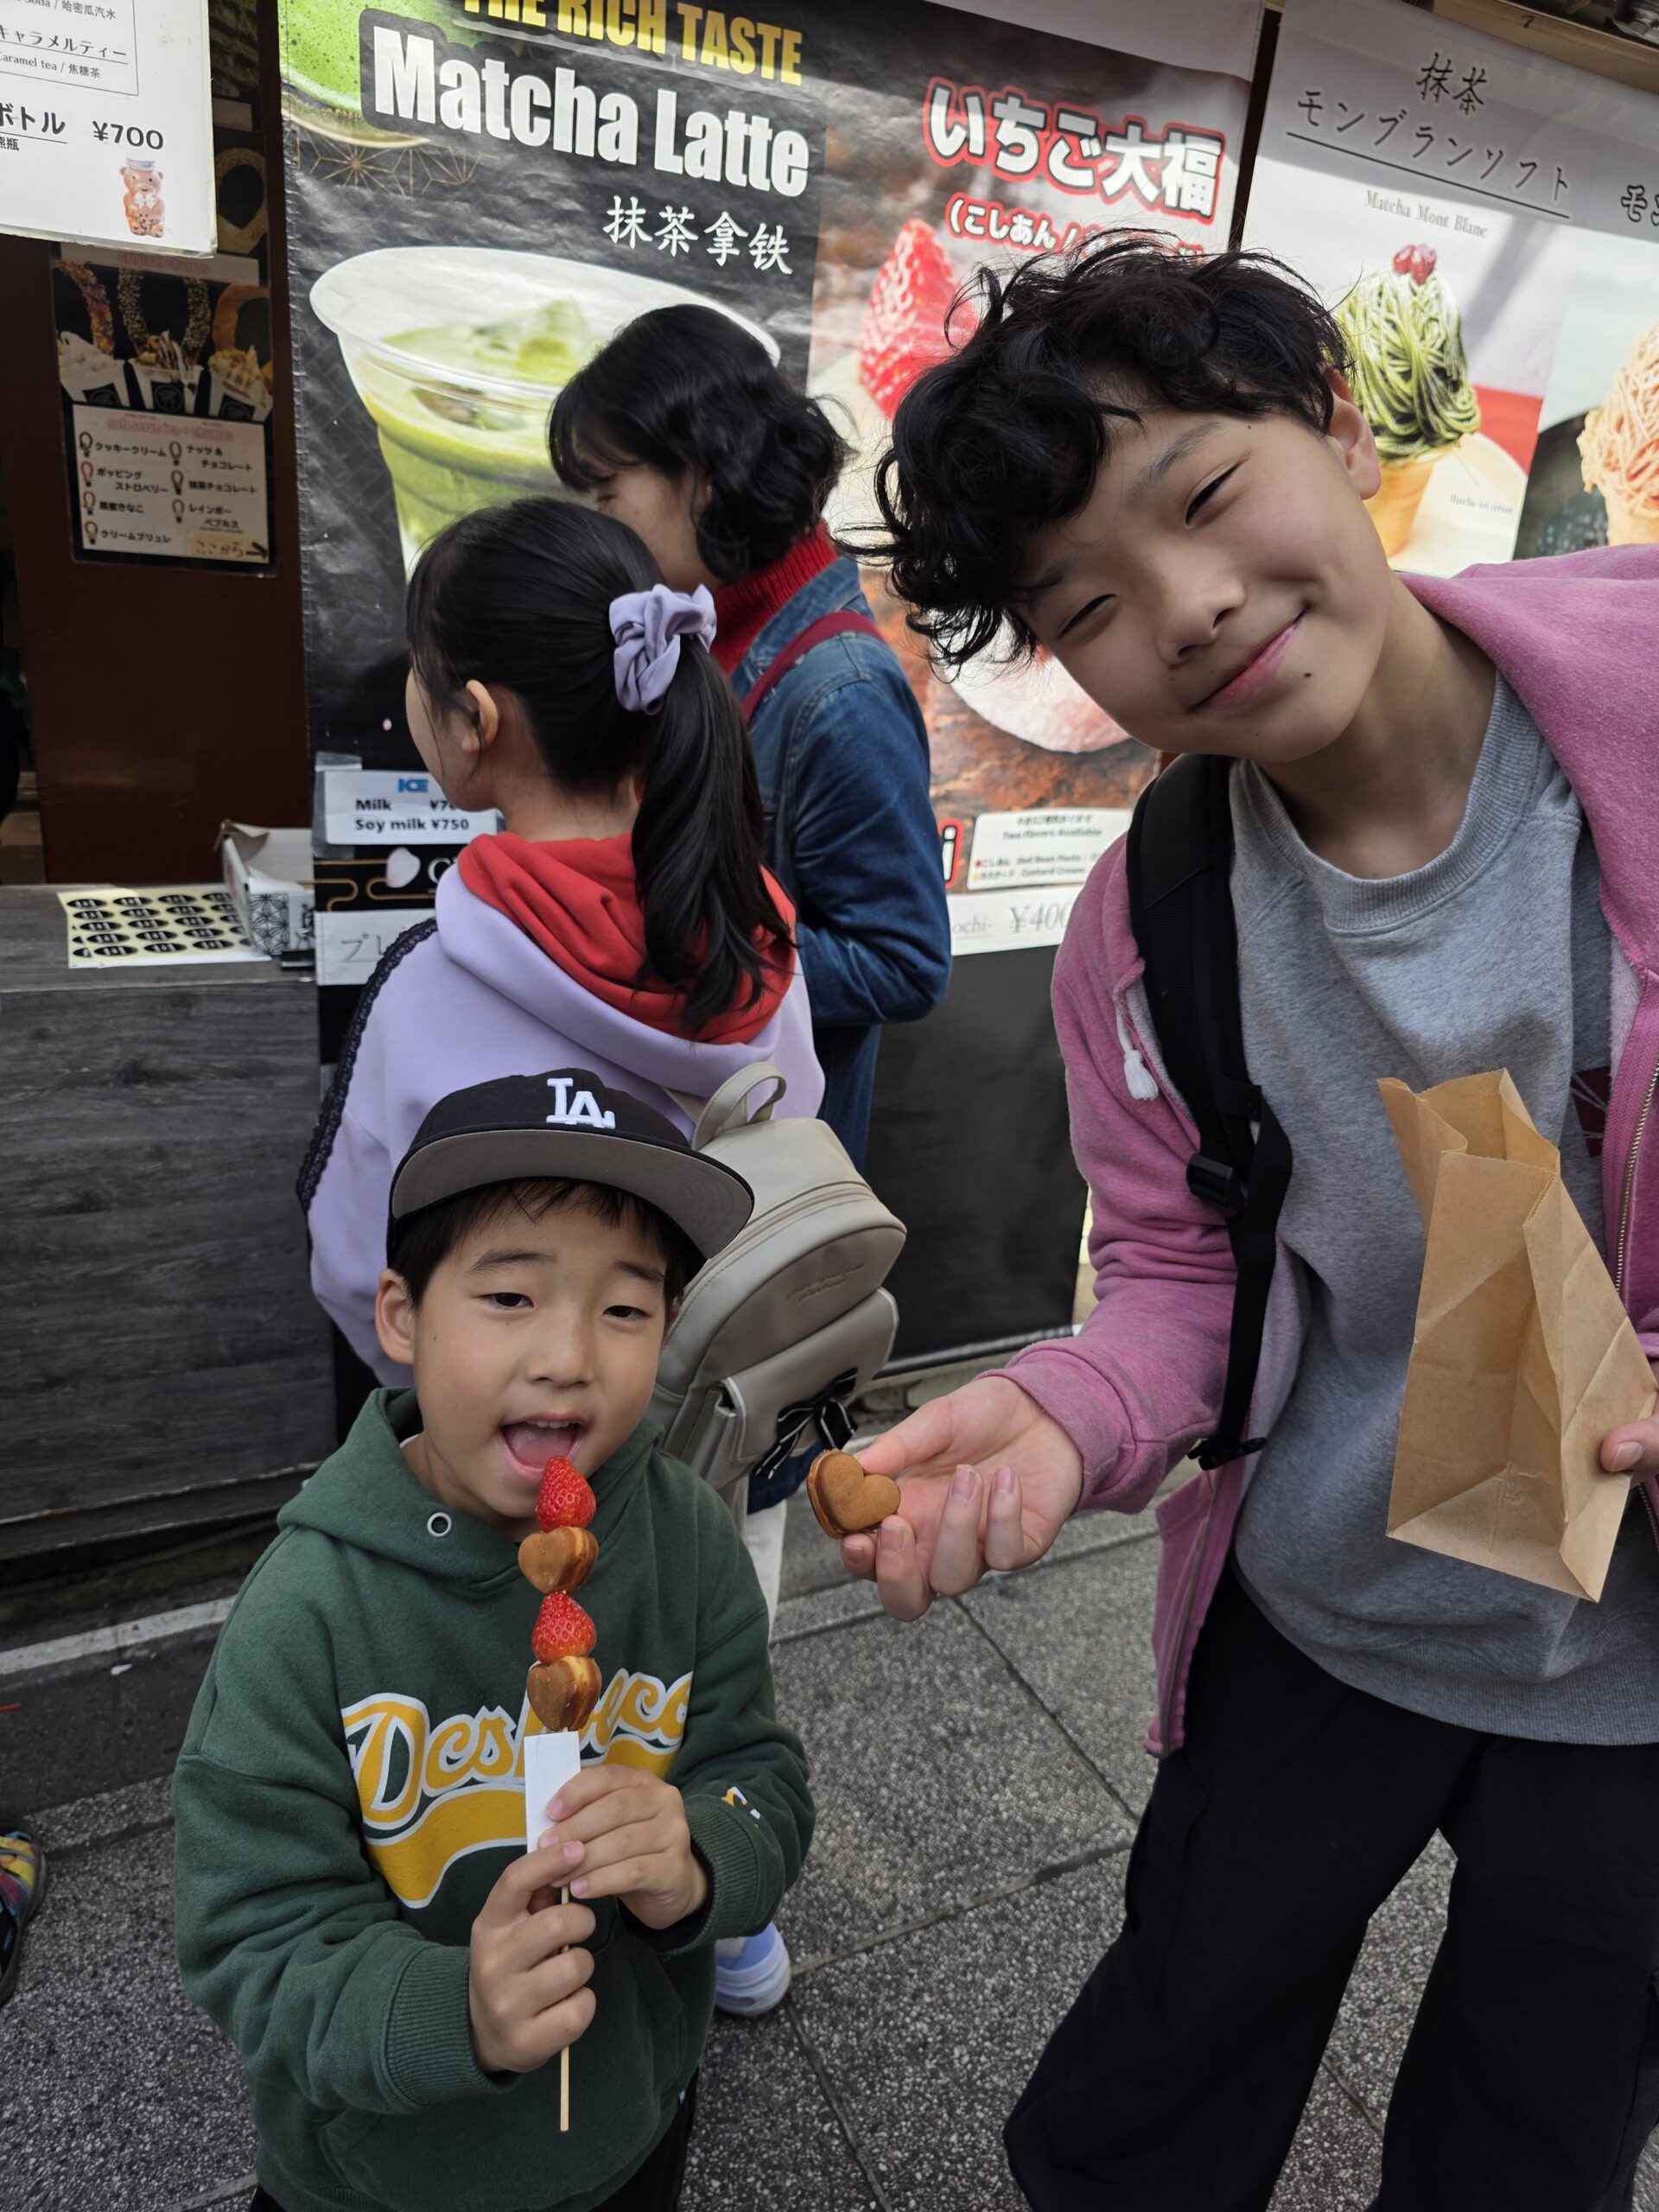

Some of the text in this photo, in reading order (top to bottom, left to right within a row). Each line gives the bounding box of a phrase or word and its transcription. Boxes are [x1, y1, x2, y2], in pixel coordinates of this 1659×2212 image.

[62, 1, 116, 20] 哈密瓜汽水
[0, 24, 127, 58] キャラメルティー
[557, 0, 803, 85] RICH TASTE
[41, 60, 57, 71] tea
[69, 64, 100, 79] 焦糖茶
[1416, 52, 1488, 115] 抹茶
[92, 120, 164, 150] ¥700
[373, 26, 809, 197] Matcha Latte
[927, 82, 1224, 221] いちご大福
[1297, 91, 1568, 201] モンブランソフト
[602, 195, 794, 276] 抹茶拿铁
[1364, 189, 1488, 238] Matcha Mont Blanc
[355, 799, 391, 811] Milk
[397, 778, 429, 793] ICE
[355, 818, 469, 834] Soy milk ¥750
[546, 1077, 615, 1129] LA
